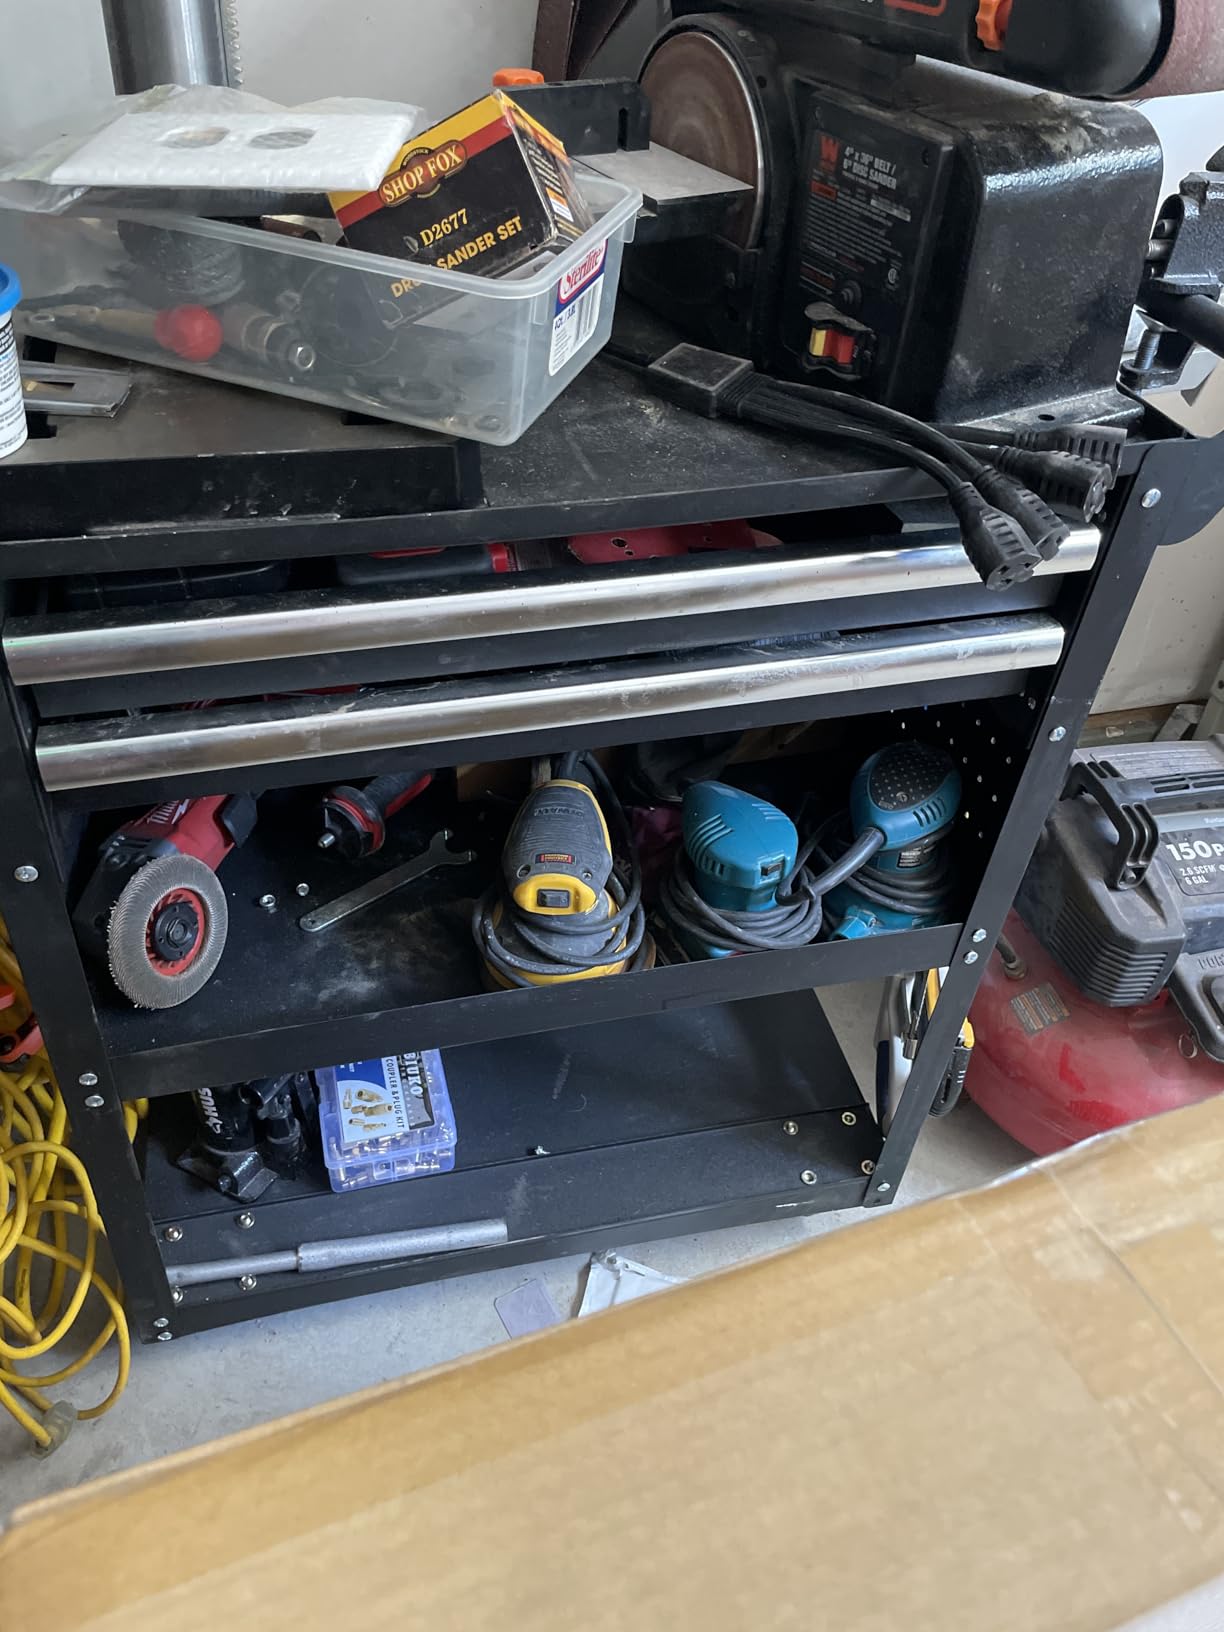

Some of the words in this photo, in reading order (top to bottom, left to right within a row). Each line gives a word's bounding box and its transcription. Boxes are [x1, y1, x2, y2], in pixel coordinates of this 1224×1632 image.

[382, 165, 424, 203] SHOP
[424, 145, 462, 178] FOX
[852, 162, 869, 178] DISC
[868, 168, 897, 190] SANDER
[874, 157, 891, 174] BELT
[419, 208, 468, 247] D2677
[436, 230, 497, 270] SANDER
[496, 215, 522, 241] SET
[1165, 840, 1214, 862] 150
[1179, 866, 1194, 877] 2.6
[1184, 876, 1193, 886] 6
[1192, 873, 1209, 884] GAL
[403, 1052, 424, 1096] BIUKO
[385, 1058, 399, 1090] COUPLER
[395, 1116, 405, 1129] KIT
